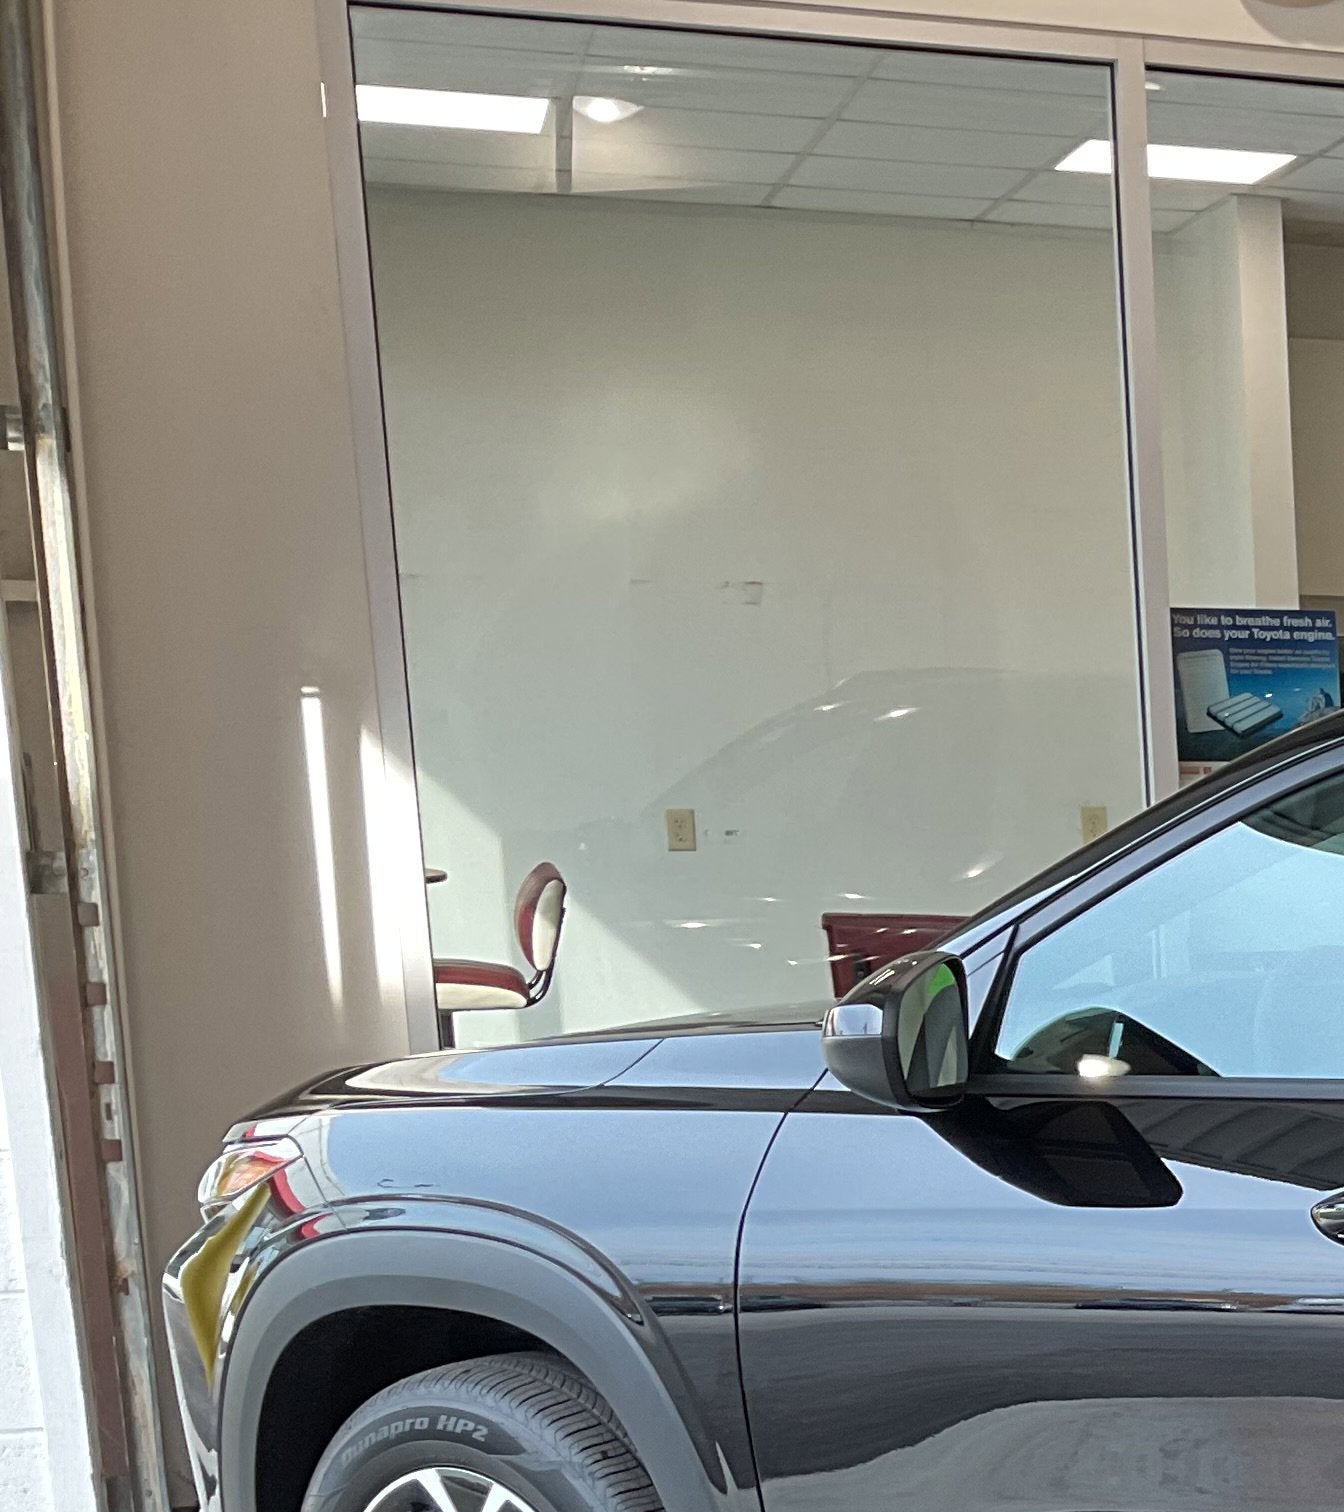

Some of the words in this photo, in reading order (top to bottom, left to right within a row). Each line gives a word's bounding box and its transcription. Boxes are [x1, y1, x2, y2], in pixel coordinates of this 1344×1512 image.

[1173, 614, 1195, 625] You
[1197, 615, 1218, 625] like
[1221, 615, 1233, 626] to
[1235, 615, 1281, 627] breathe
[1283, 617, 1312, 628] fresh
[1315, 617, 1333, 628] air.
[1173, 627, 1190, 638] So
[1192, 627, 1222, 639] does
[1224, 629, 1251, 641] your
[1252, 628, 1291, 642] Toyota
[1293, 630, 1336, 643] engine.
[435, 1415, 490, 1443] HP2
